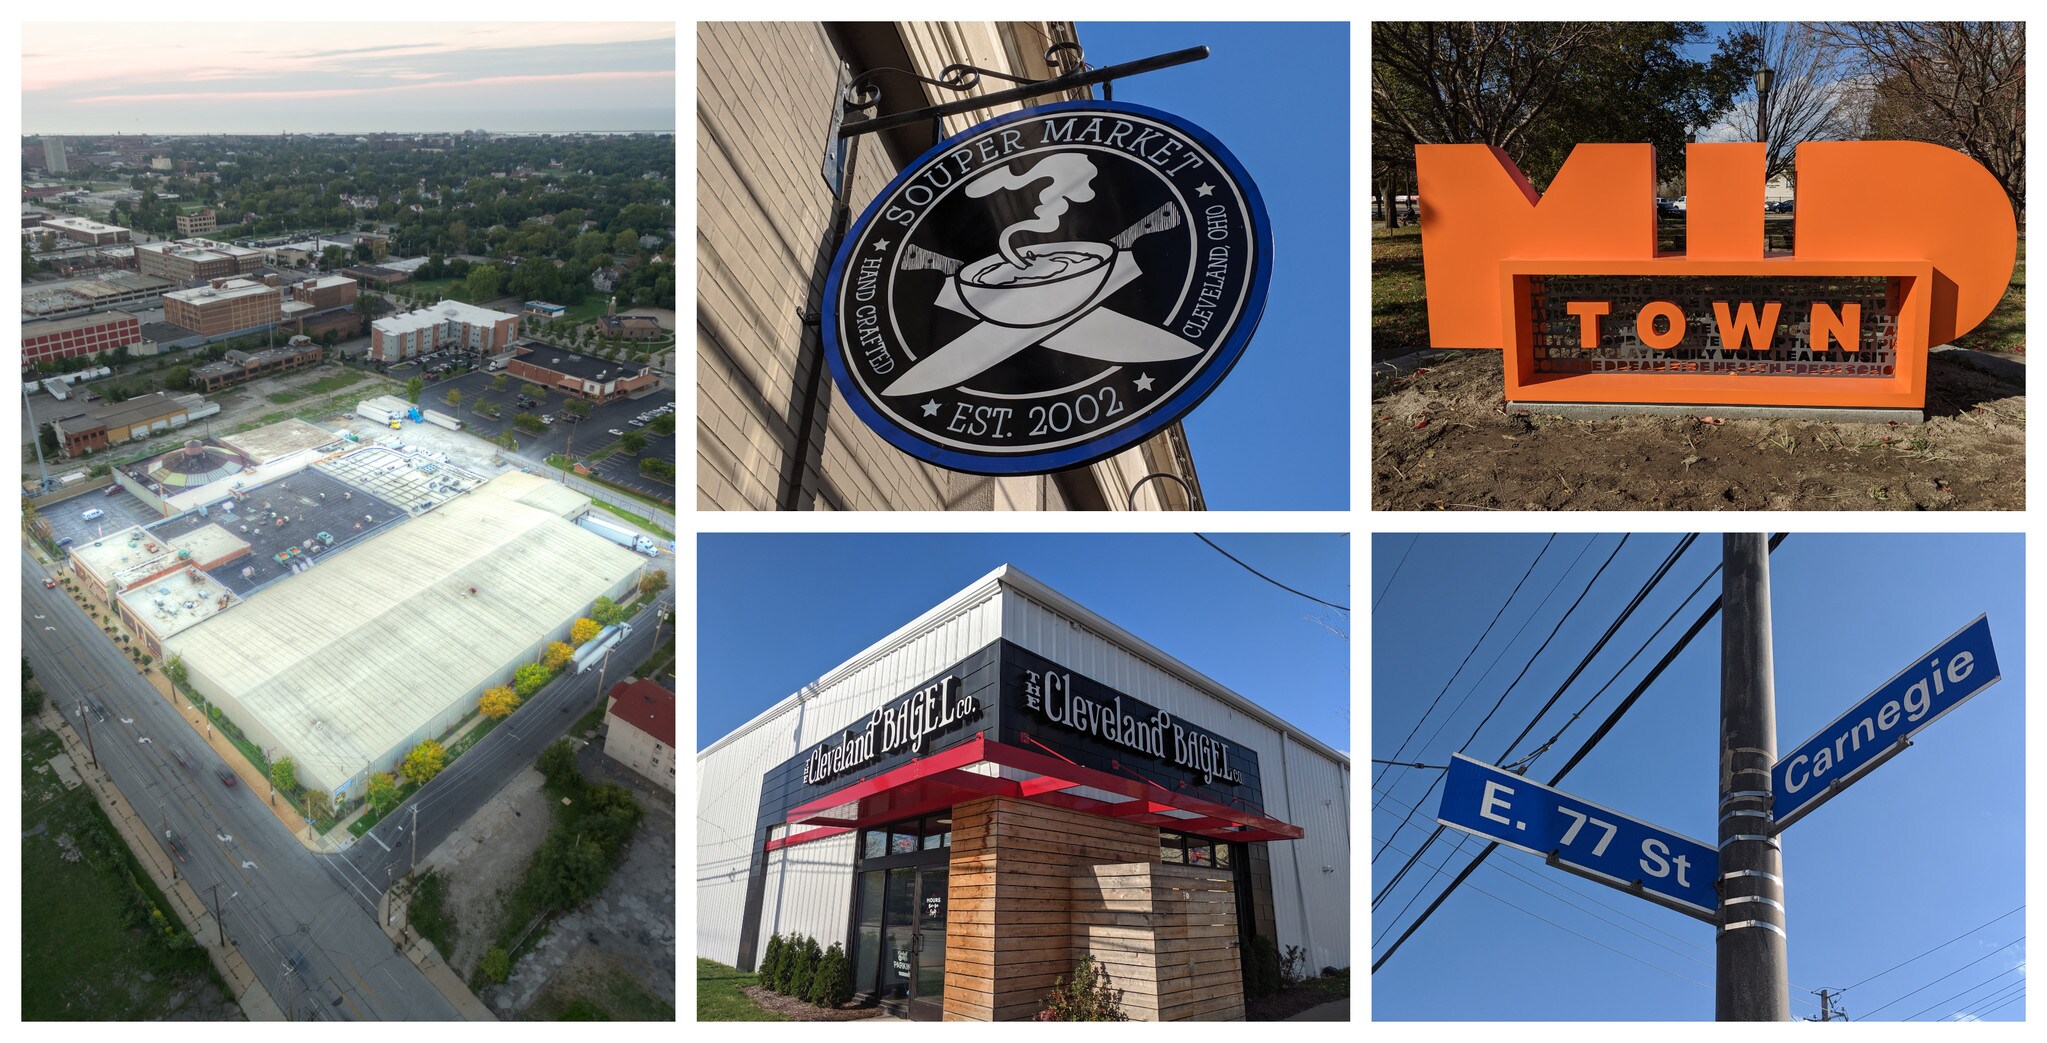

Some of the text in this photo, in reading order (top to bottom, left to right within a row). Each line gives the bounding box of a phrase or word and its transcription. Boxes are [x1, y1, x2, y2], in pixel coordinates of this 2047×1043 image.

[886, 118, 1204, 227] SOUPER MARKET
[1182, 204, 1231, 339] CLEVELAND, OHIO
[1415, 141, 2017, 348] MID
[855, 257, 896, 376] HAND CRAFTED
[1567, 301, 1861, 352] TOWN
[1653, 348, 1716, 360] FAMILY
[1720, 349, 1773, 361] WORK
[1776, 350, 1837, 362] LEARN
[1841, 352, 1887, 363] VISIT
[1714, 362, 1781, 374] HEALTH
[947, 387, 1124, 438] EST. 2002
[803, 758, 811, 784] THE
[808, 705, 884, 785] Cleveland
[881, 674, 955, 753] BAGEL
[1026, 669, 1041, 712] THE
[1044, 670, 1171, 759] Cleveland
[1172, 722, 1234, 785] BAGEL
[1783, 650, 1975, 795] Carnegie
[1479, 780, 1692, 889] E. 77 St
